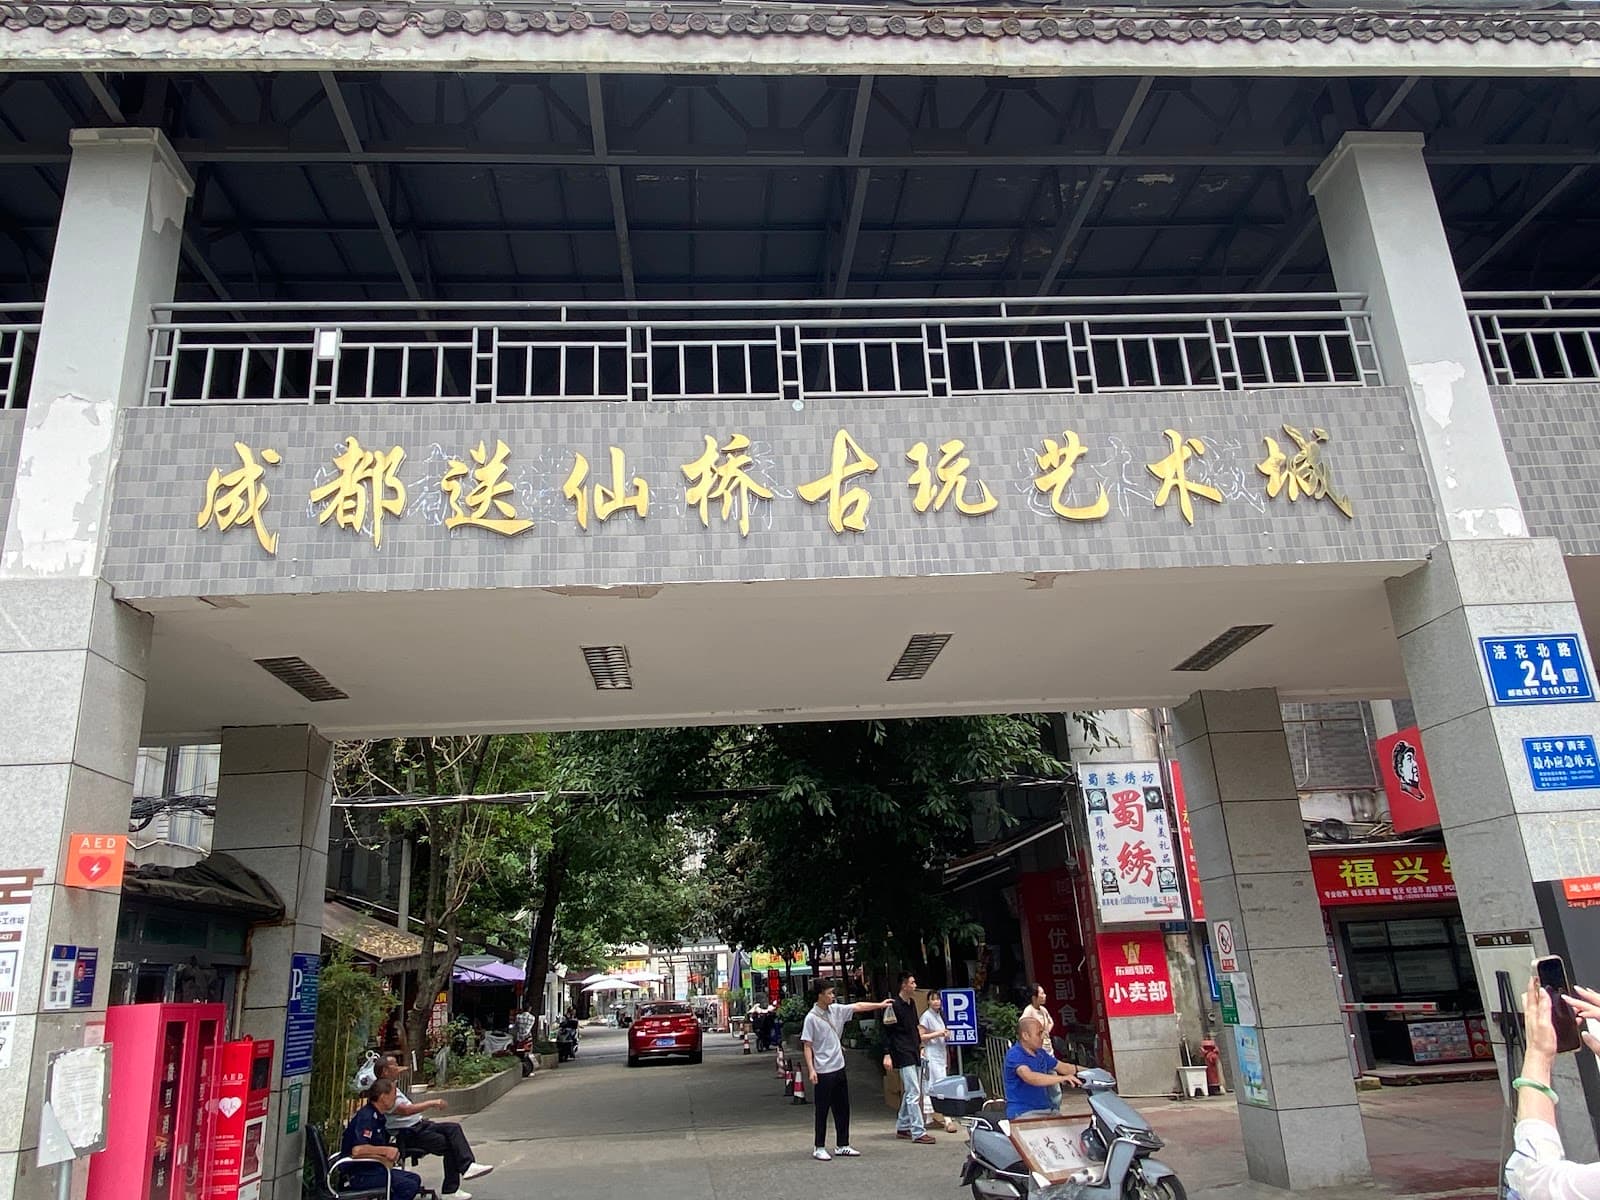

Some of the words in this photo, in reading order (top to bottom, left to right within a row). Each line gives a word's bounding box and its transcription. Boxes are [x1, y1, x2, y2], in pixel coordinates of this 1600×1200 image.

[198, 424, 1353, 555] 成都送仙桥古玩艺术城
[1493, 642, 1571, 660] 浣花北路
[1520, 659, 1558, 687] 24
[1541, 686, 1580, 696] 610072
[1532, 742, 1553, 753] 平安
[1533, 754, 1596, 770] 最小应急单元
[80, 837, 116, 849] AED
[289, 969, 303, 1000] P
[1109, 980, 1168, 1003] 小卖部
[947, 993, 969, 1021] P
